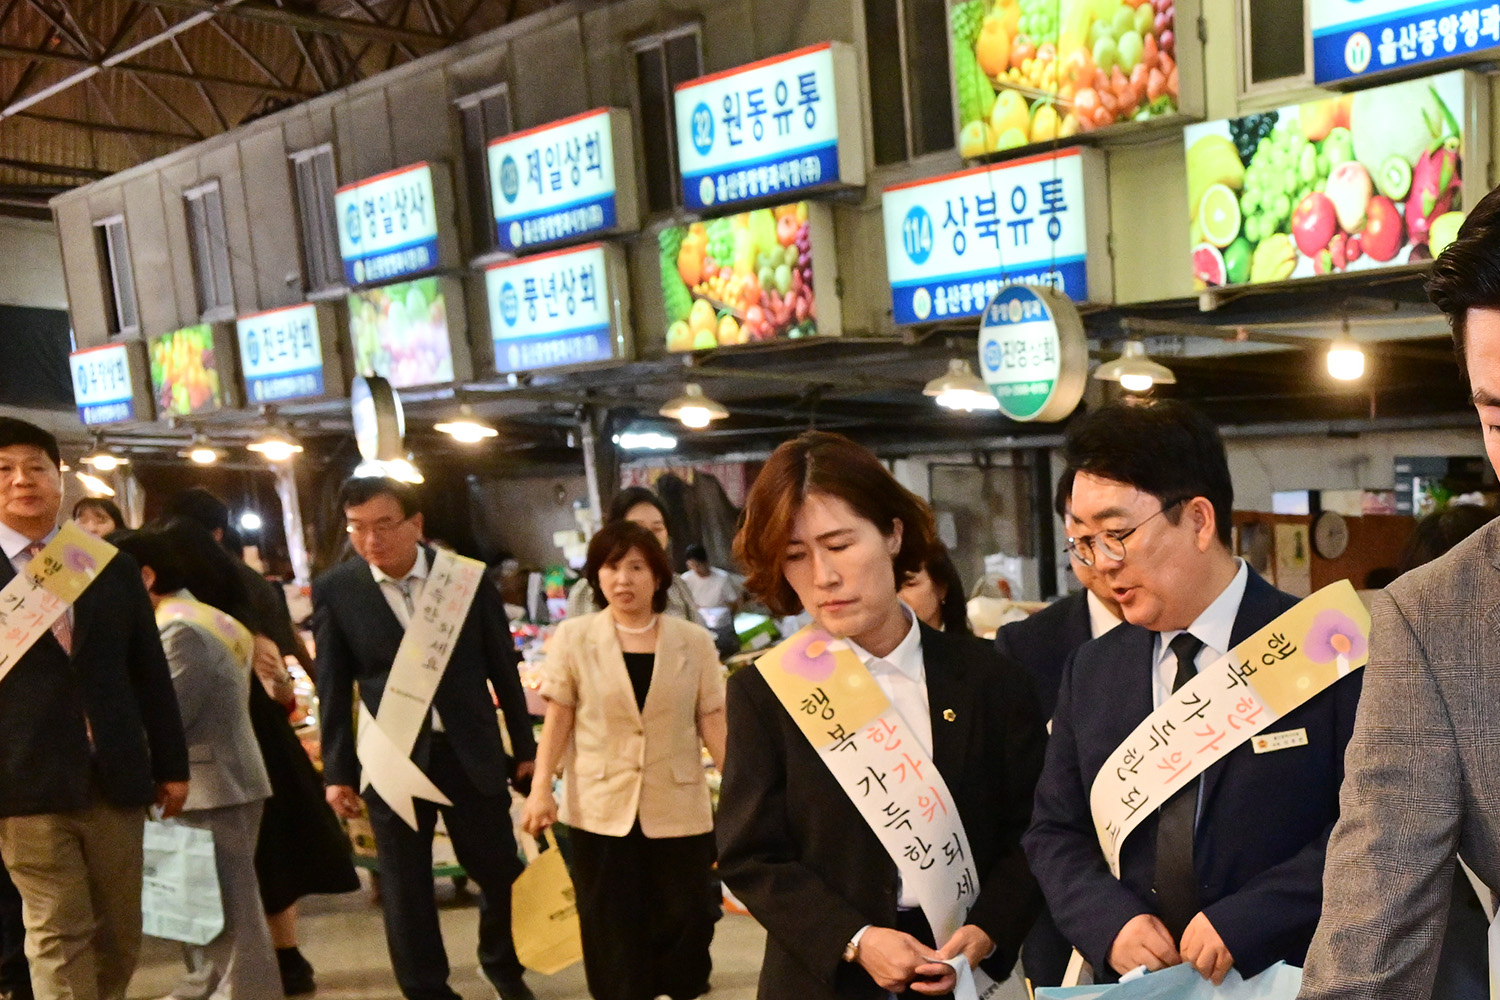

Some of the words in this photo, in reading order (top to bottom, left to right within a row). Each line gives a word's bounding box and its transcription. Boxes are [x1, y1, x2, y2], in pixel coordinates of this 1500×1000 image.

[694, 109, 713, 147] 32
[722, 71, 821, 147] 원동유통
[526, 130, 603, 195] 제일상회
[905, 213, 932, 254] 114
[943, 178, 1068, 256] 상북유통
[523, 263, 598, 322] 풍년상회
[1226, 632, 1297, 690] 행복
[1116, 692, 1212, 782] 가득한
[1157, 696, 1264, 785] 한가위
[799, 687, 858, 752] 행복
[856, 766, 935, 870] 가득한
[866, 717, 948, 823] 한가위
[942, 832, 976, 914] 되세
